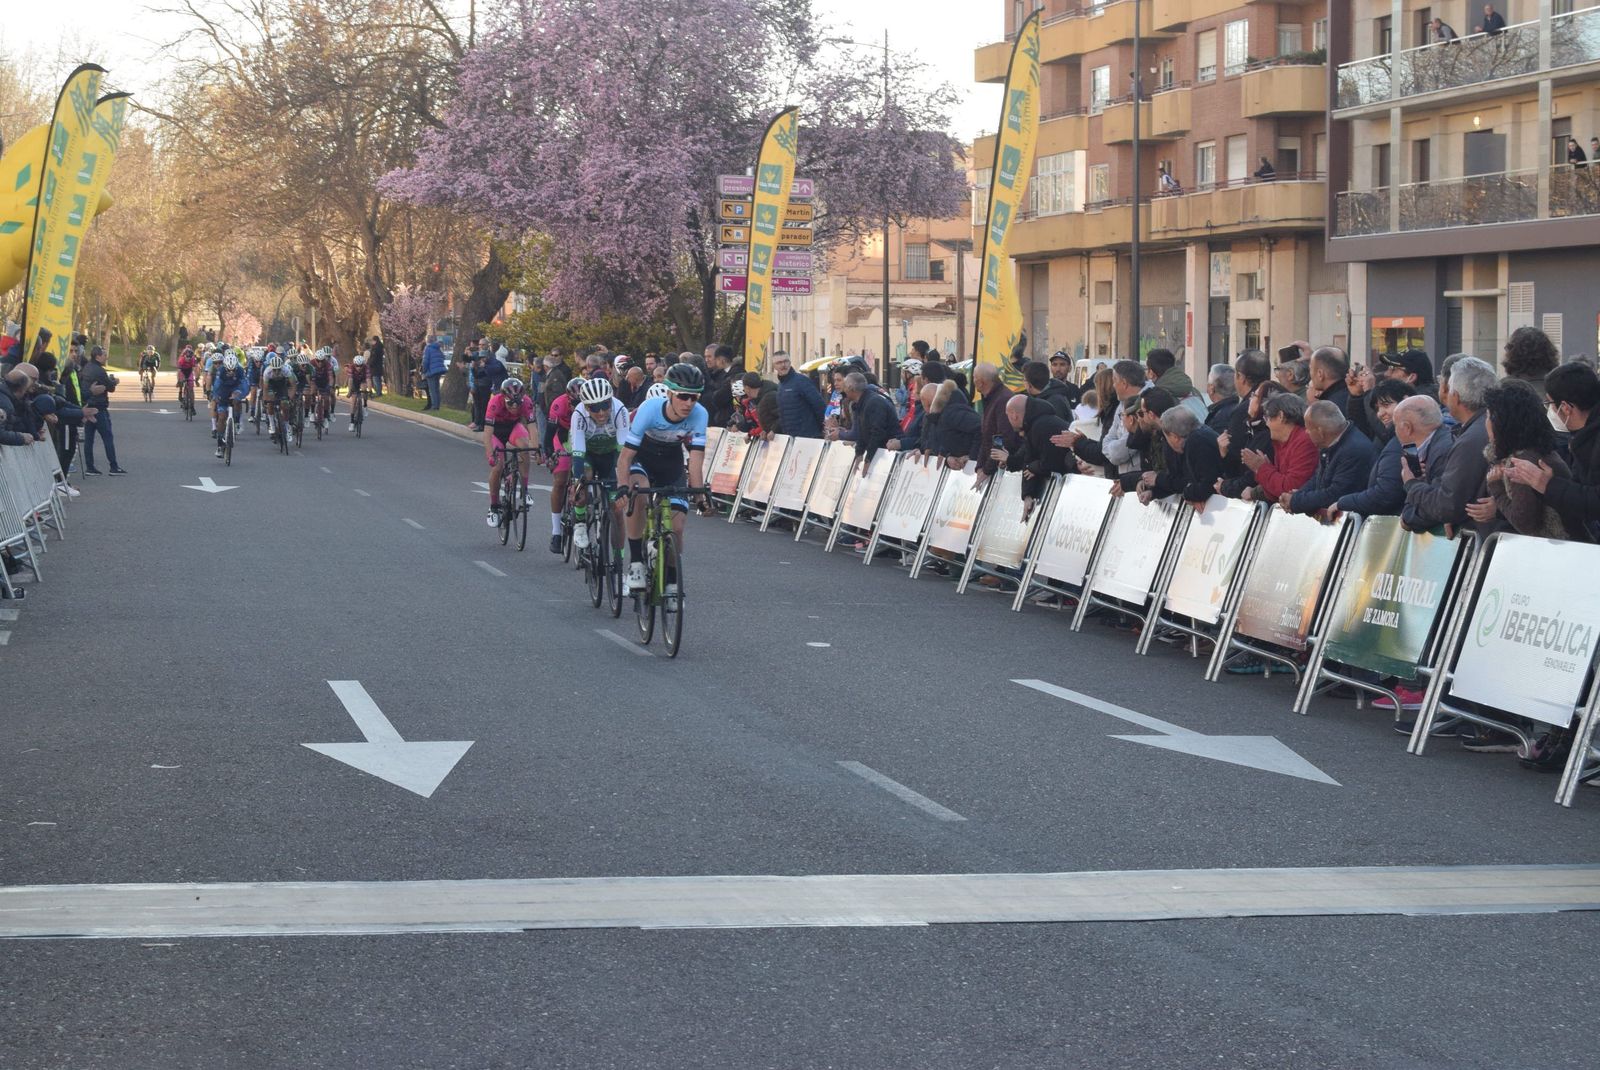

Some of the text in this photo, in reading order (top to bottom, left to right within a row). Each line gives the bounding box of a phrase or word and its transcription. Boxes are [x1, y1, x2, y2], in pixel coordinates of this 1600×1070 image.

[781, 232, 809, 240] parador
[1371, 572, 1437, 609] CAJA RURAL
[1511, 592, 1531, 607] GRUPO
[1363, 607, 1400, 628] DE ZAMORA
[1500, 610, 1592, 658] IBEREÓLICA
